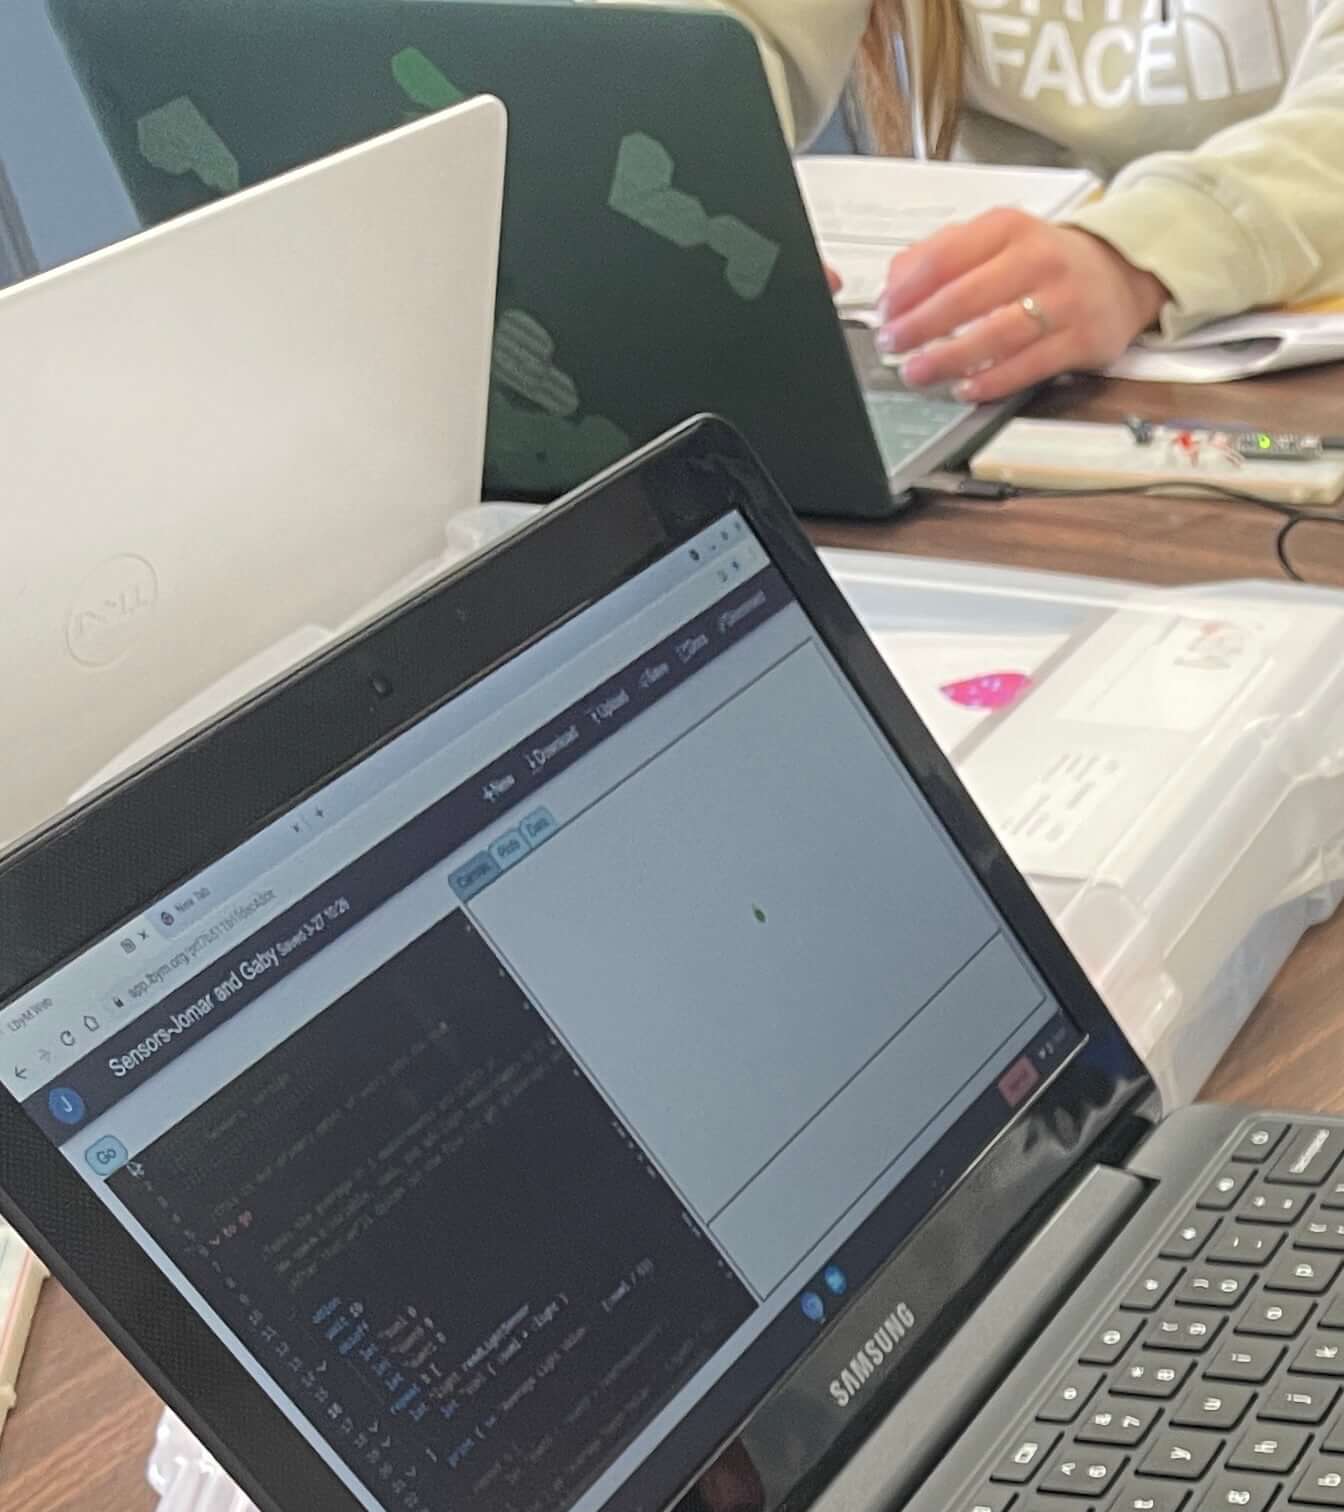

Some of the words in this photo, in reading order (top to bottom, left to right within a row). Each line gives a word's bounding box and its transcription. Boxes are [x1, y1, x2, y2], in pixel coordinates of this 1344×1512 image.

[976, 12, 1188, 109] FACE
[106, 989, 215, 1077] Sensors-Jomar
[211, 972, 241, 1000] and
[239, 945, 281, 984] Gaby
[97, 1147, 118, 1165] Go
[1295, 1263, 1314, 1277] p
[1220, 1279, 1238, 1292] 0
[1266, 1307, 1283, 1320] o
[1189, 1322, 1207, 1335] 9
[829, 1301, 915, 1408] SAMSUNG
[1231, 1353, 1251, 1363] i
[1315, 1346, 1338, 1358] k
[1156, 1368, 1175, 1381] 8
[1204, 1398, 1222, 1411] u
[1287, 1393, 1312, 1405] j
[1122, 1415, 1140, 1428] 7
[1170, 1446, 1192, 1461] y
[1253, 1440, 1278, 1454] h
[1088, 1465, 1107, 1478] 6
[1317, 1473, 1342, 1487] b
[1133, 1499, 1154, 1509] t
[1227, 1490, 1250, 1505] g
